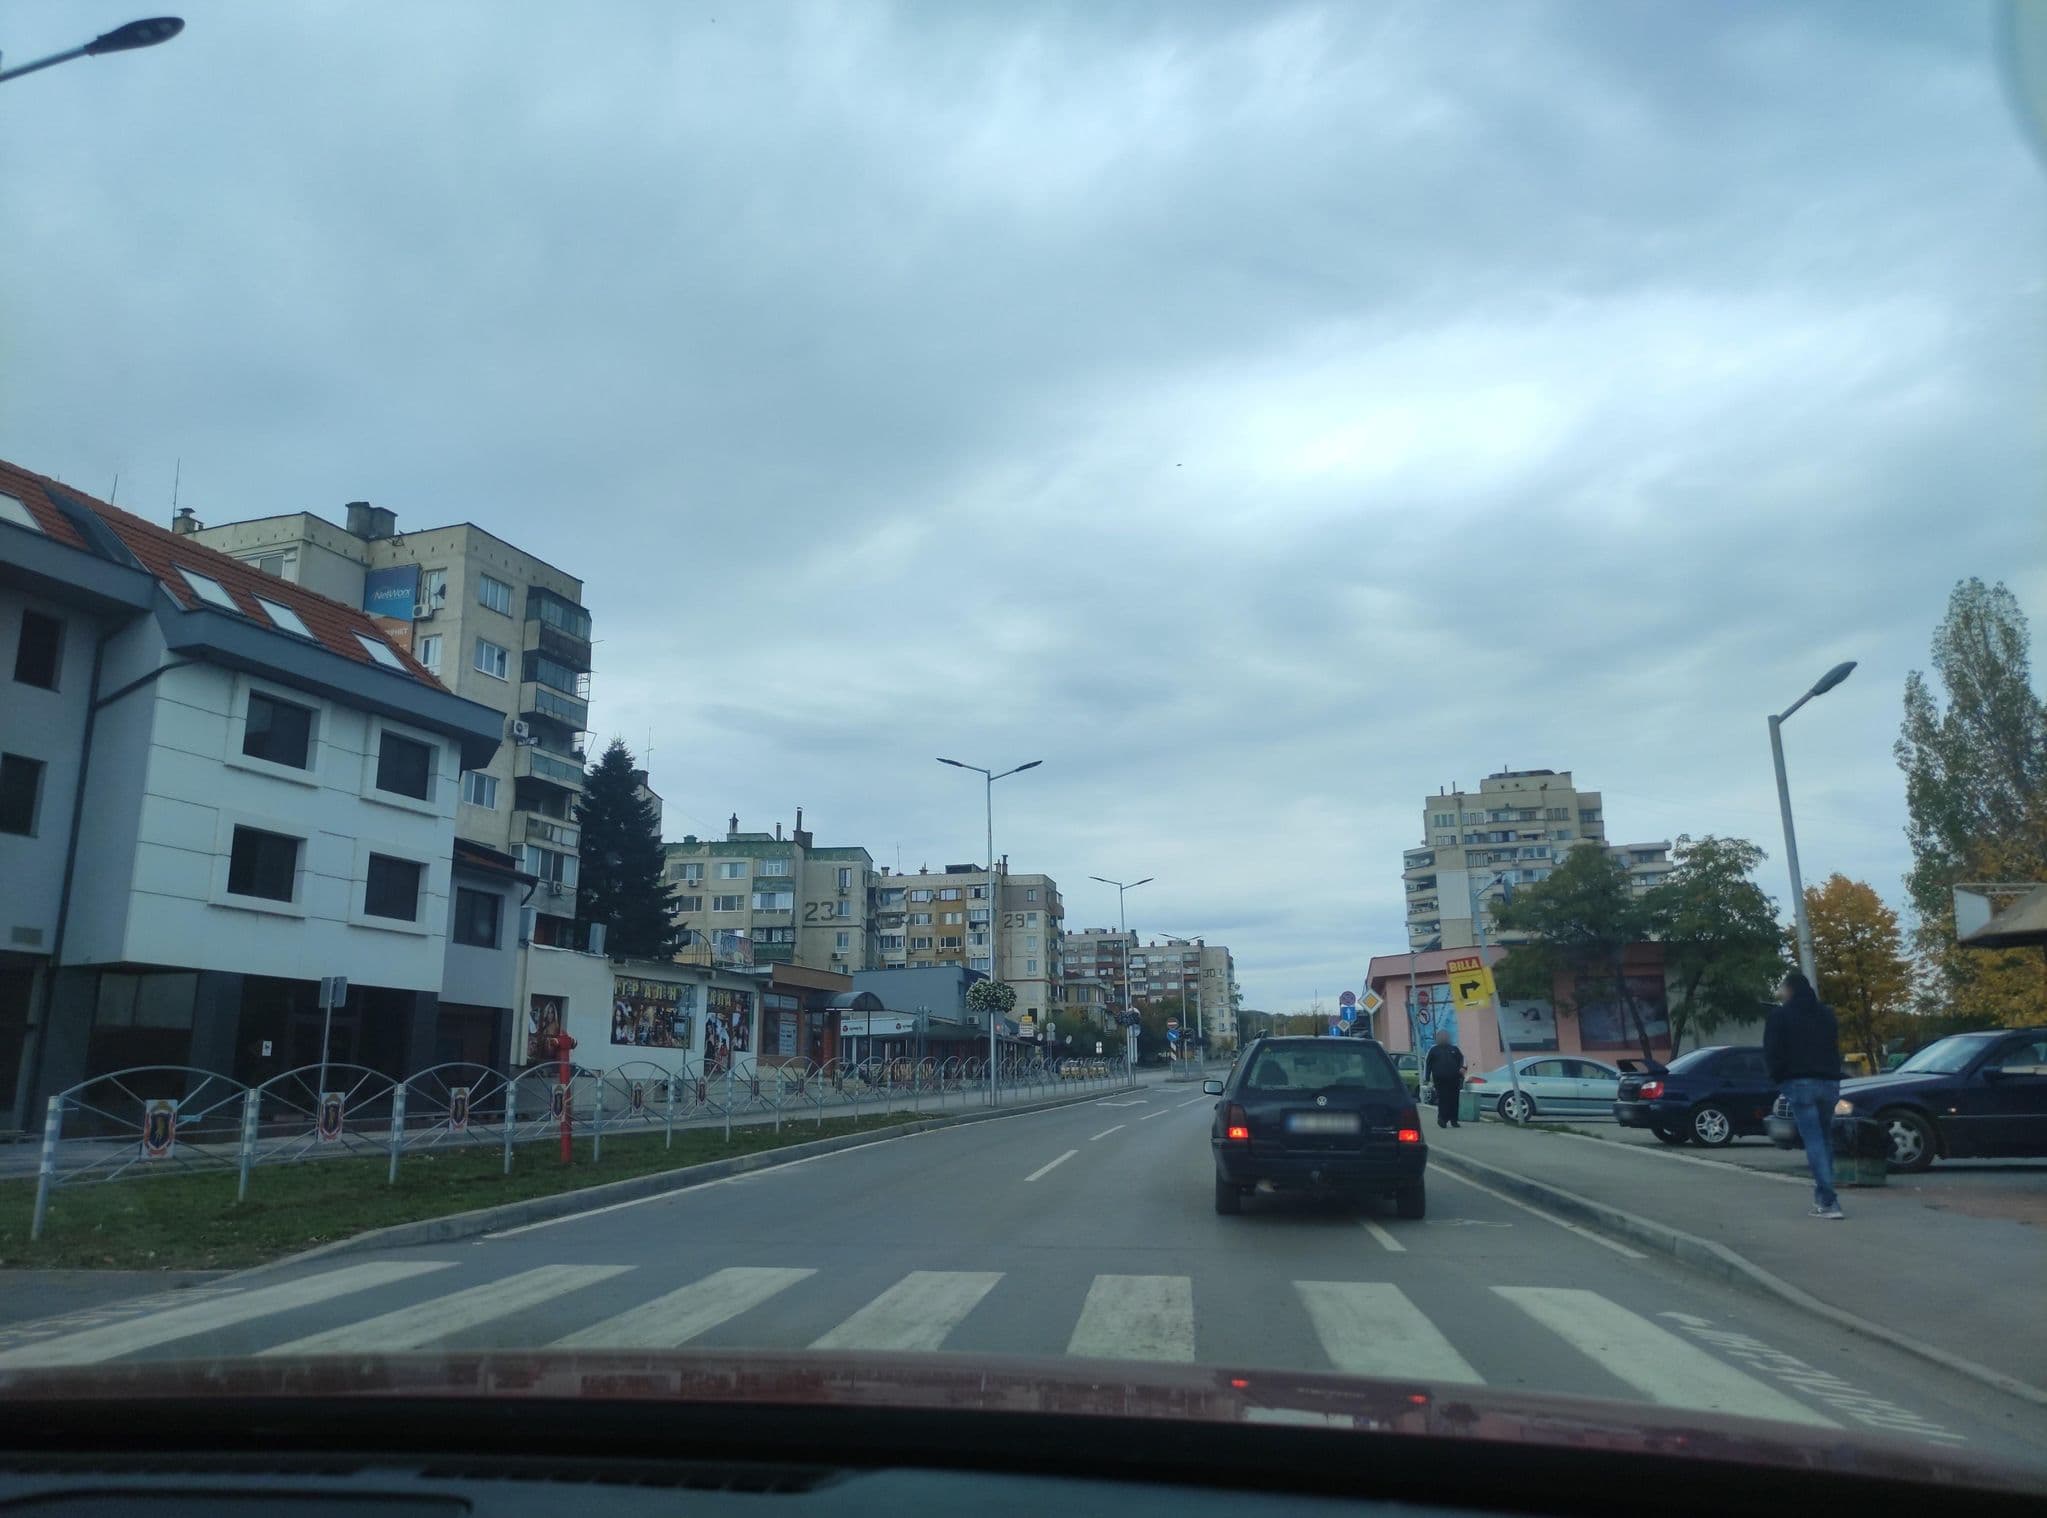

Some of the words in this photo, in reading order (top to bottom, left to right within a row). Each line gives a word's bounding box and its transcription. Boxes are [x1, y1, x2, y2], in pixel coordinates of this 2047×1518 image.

[804, 901, 835, 922] 23
[1004, 913, 1025, 929] 29
[1202, 968, 1216, 978] 30
[1448, 958, 1480, 973] BILLA
